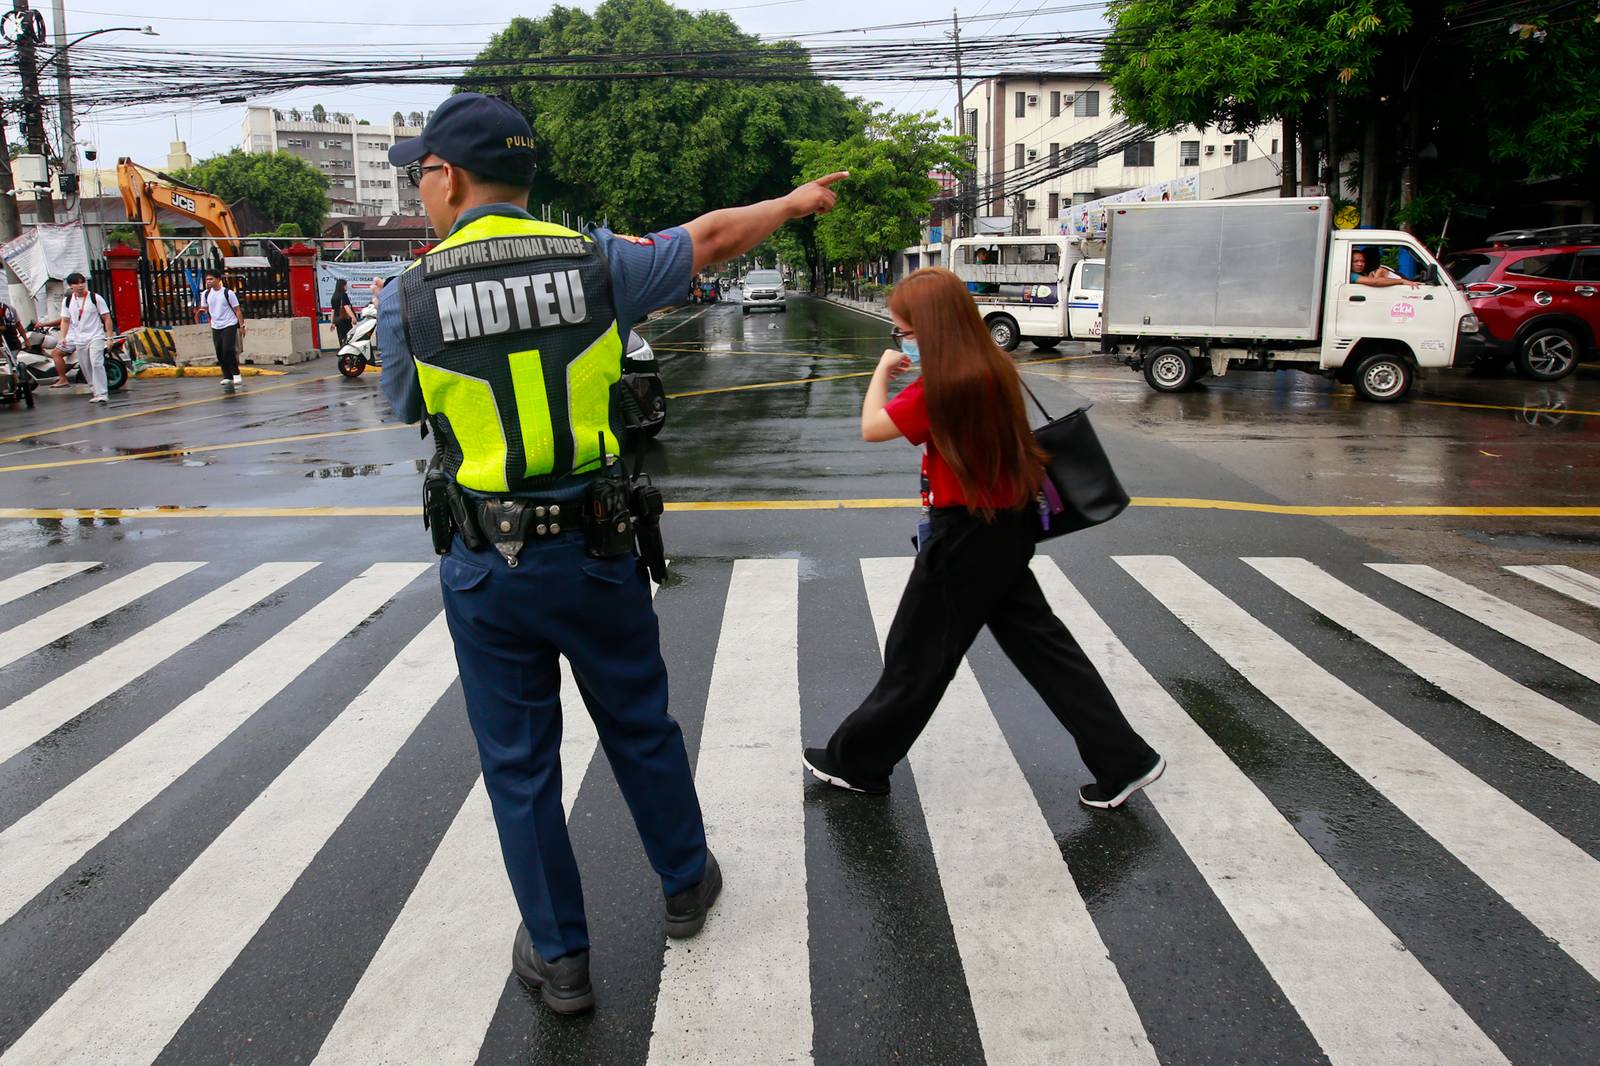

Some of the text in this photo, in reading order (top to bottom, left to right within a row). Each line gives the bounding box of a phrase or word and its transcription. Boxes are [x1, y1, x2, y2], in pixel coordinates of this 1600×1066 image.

[171, 192, 195, 212] JCB
[425, 237, 586, 273] PHILIPPINE NATIONAL POLICE
[434, 269, 587, 342] MDTEU
